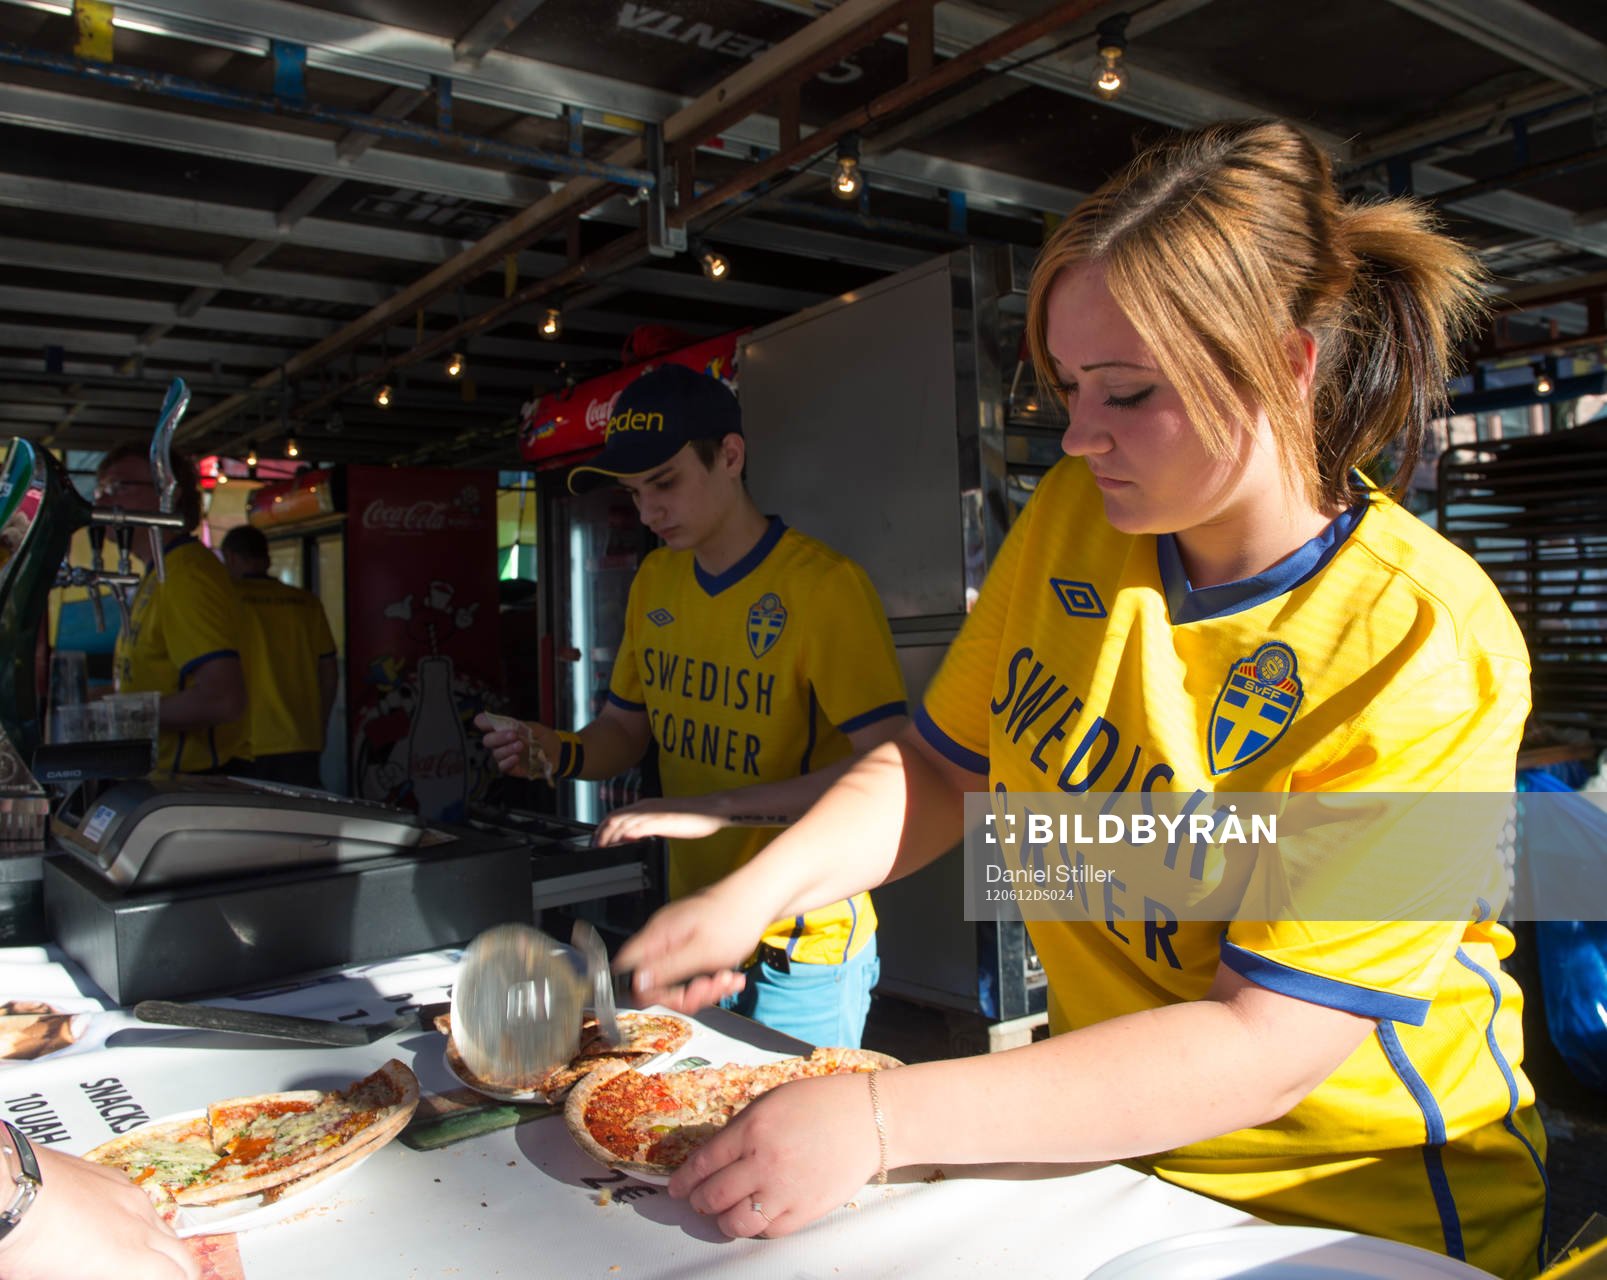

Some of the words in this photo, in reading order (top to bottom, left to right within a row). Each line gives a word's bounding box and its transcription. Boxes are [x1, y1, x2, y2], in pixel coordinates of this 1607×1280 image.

[605, 407, 664, 442] eden
[644, 648, 776, 716] SWEDISH
[1244, 680, 1282, 700] SvFF
[46, 769, 82, 779] CASIO
[991, 647, 1230, 881] SWEDISH
[996, 781, 1183, 970] ORNER
[5, 1093, 48, 1112] 10
[80, 1077, 151, 1134] SNACKS
[15, 1110, 72, 1145] UAH
